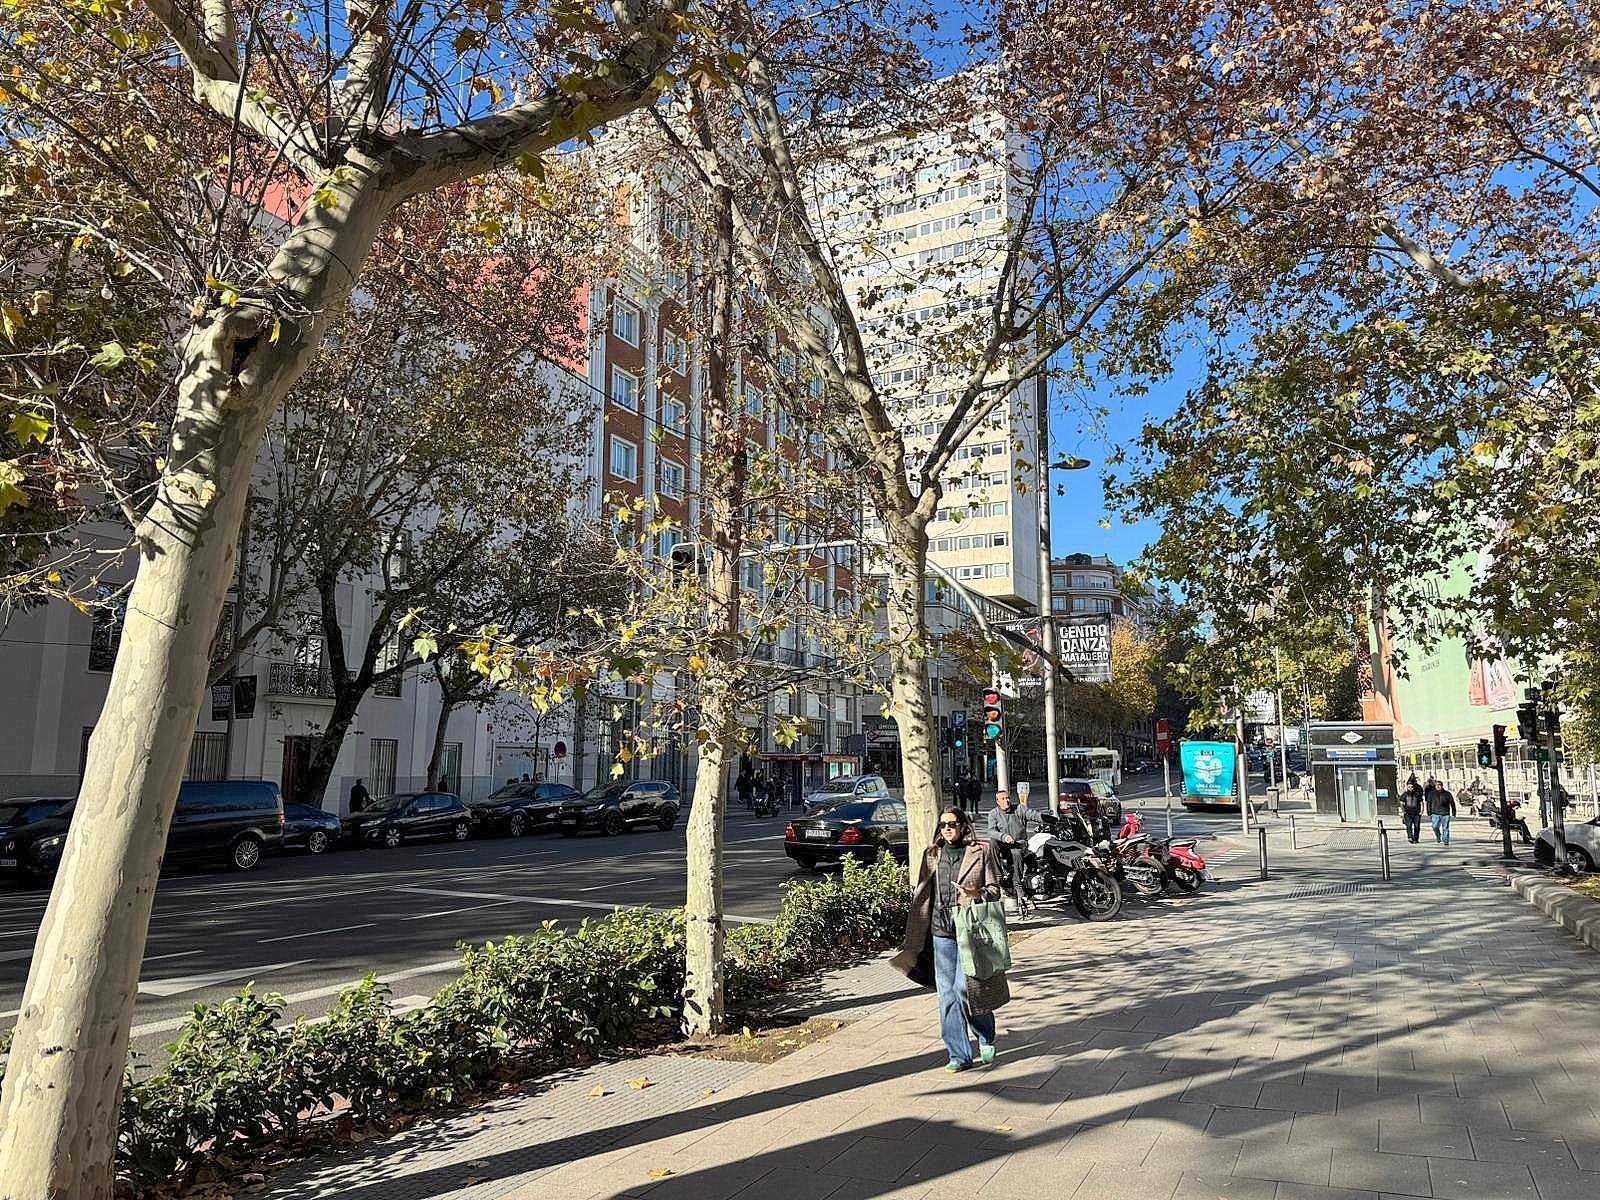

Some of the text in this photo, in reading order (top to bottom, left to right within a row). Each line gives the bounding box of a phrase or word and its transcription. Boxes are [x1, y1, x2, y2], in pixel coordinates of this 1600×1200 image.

[1060, 625, 1107, 638] CENTRO
[1061, 637, 1108, 652] DANZA
[1061, 651, 1109, 661] MATADERO
